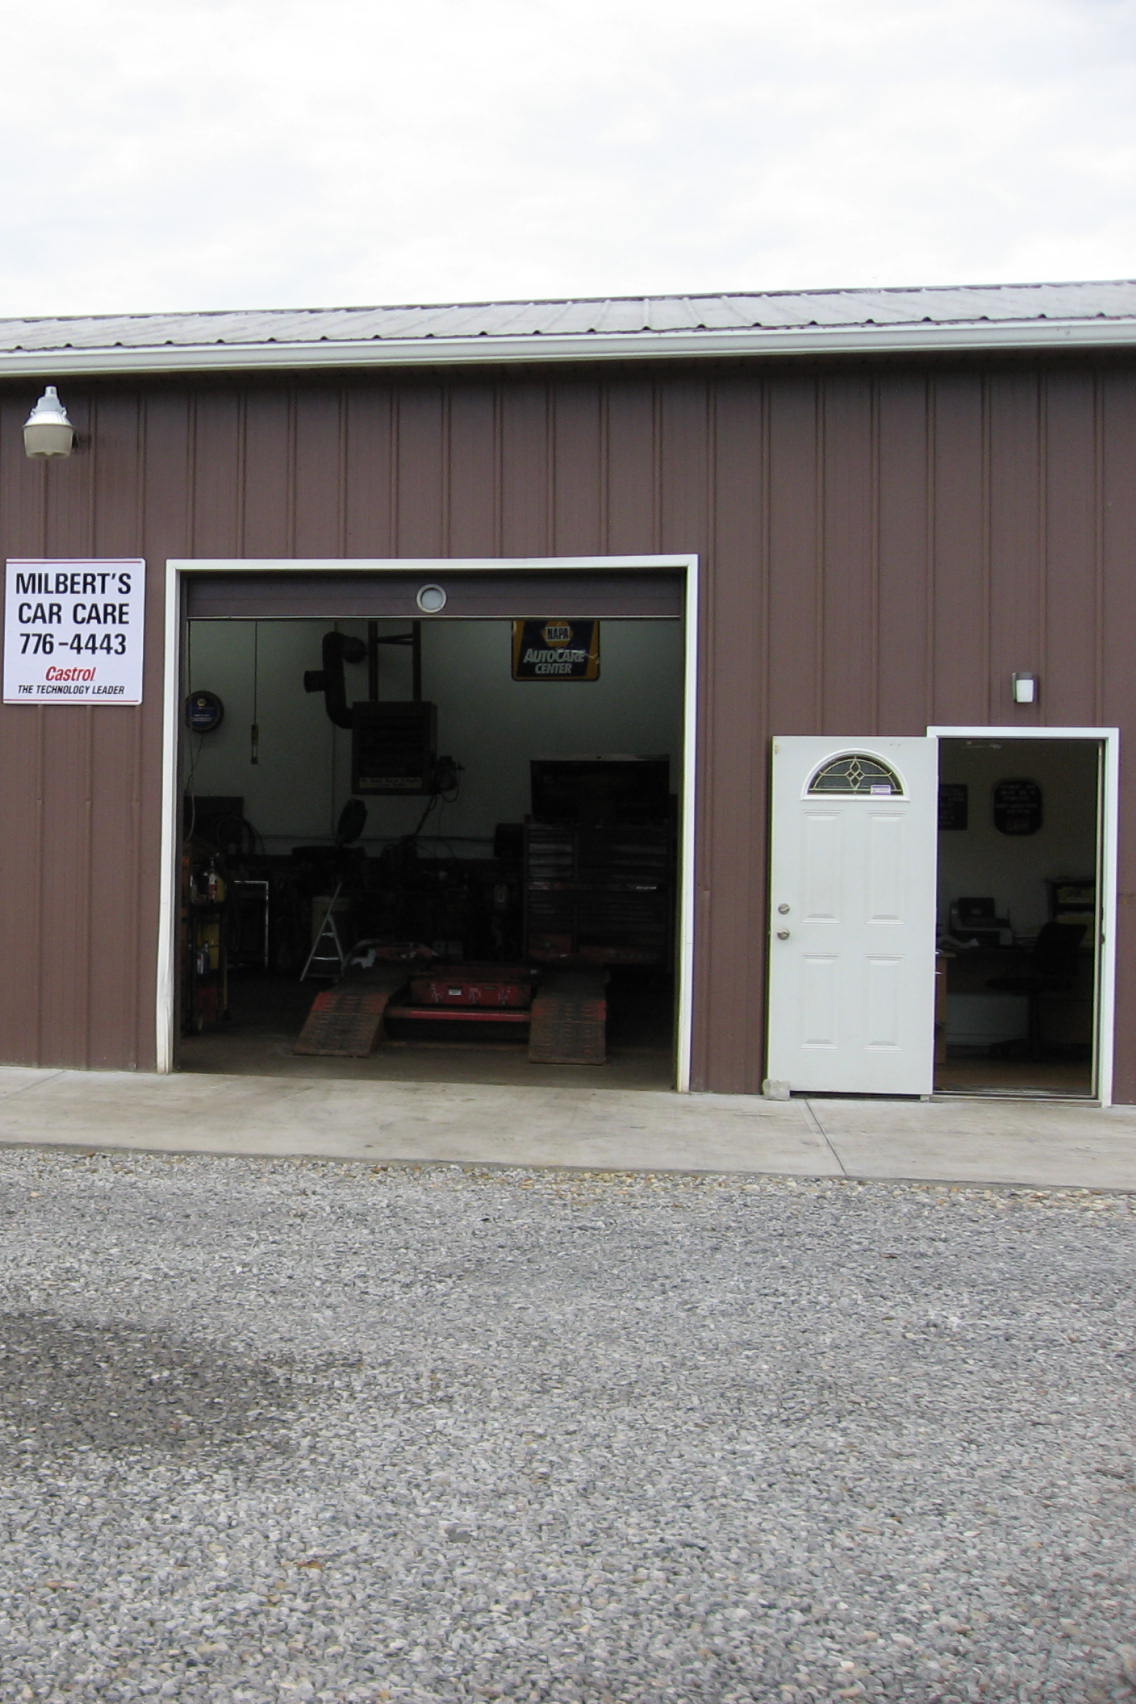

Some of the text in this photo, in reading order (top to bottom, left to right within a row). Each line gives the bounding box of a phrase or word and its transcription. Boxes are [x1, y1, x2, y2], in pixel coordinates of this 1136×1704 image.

[15, 572, 132, 595] MILBERT'S
[18, 602, 130, 625] CAR CARE
[547, 627, 569, 640] NAPA
[19, 633, 127, 655] 776-4443
[45, 665, 97, 682] Castrol
[534, 663, 573, 674] CENTER
[18, 685, 125, 695] THE TECHNOLOGY LEADER
